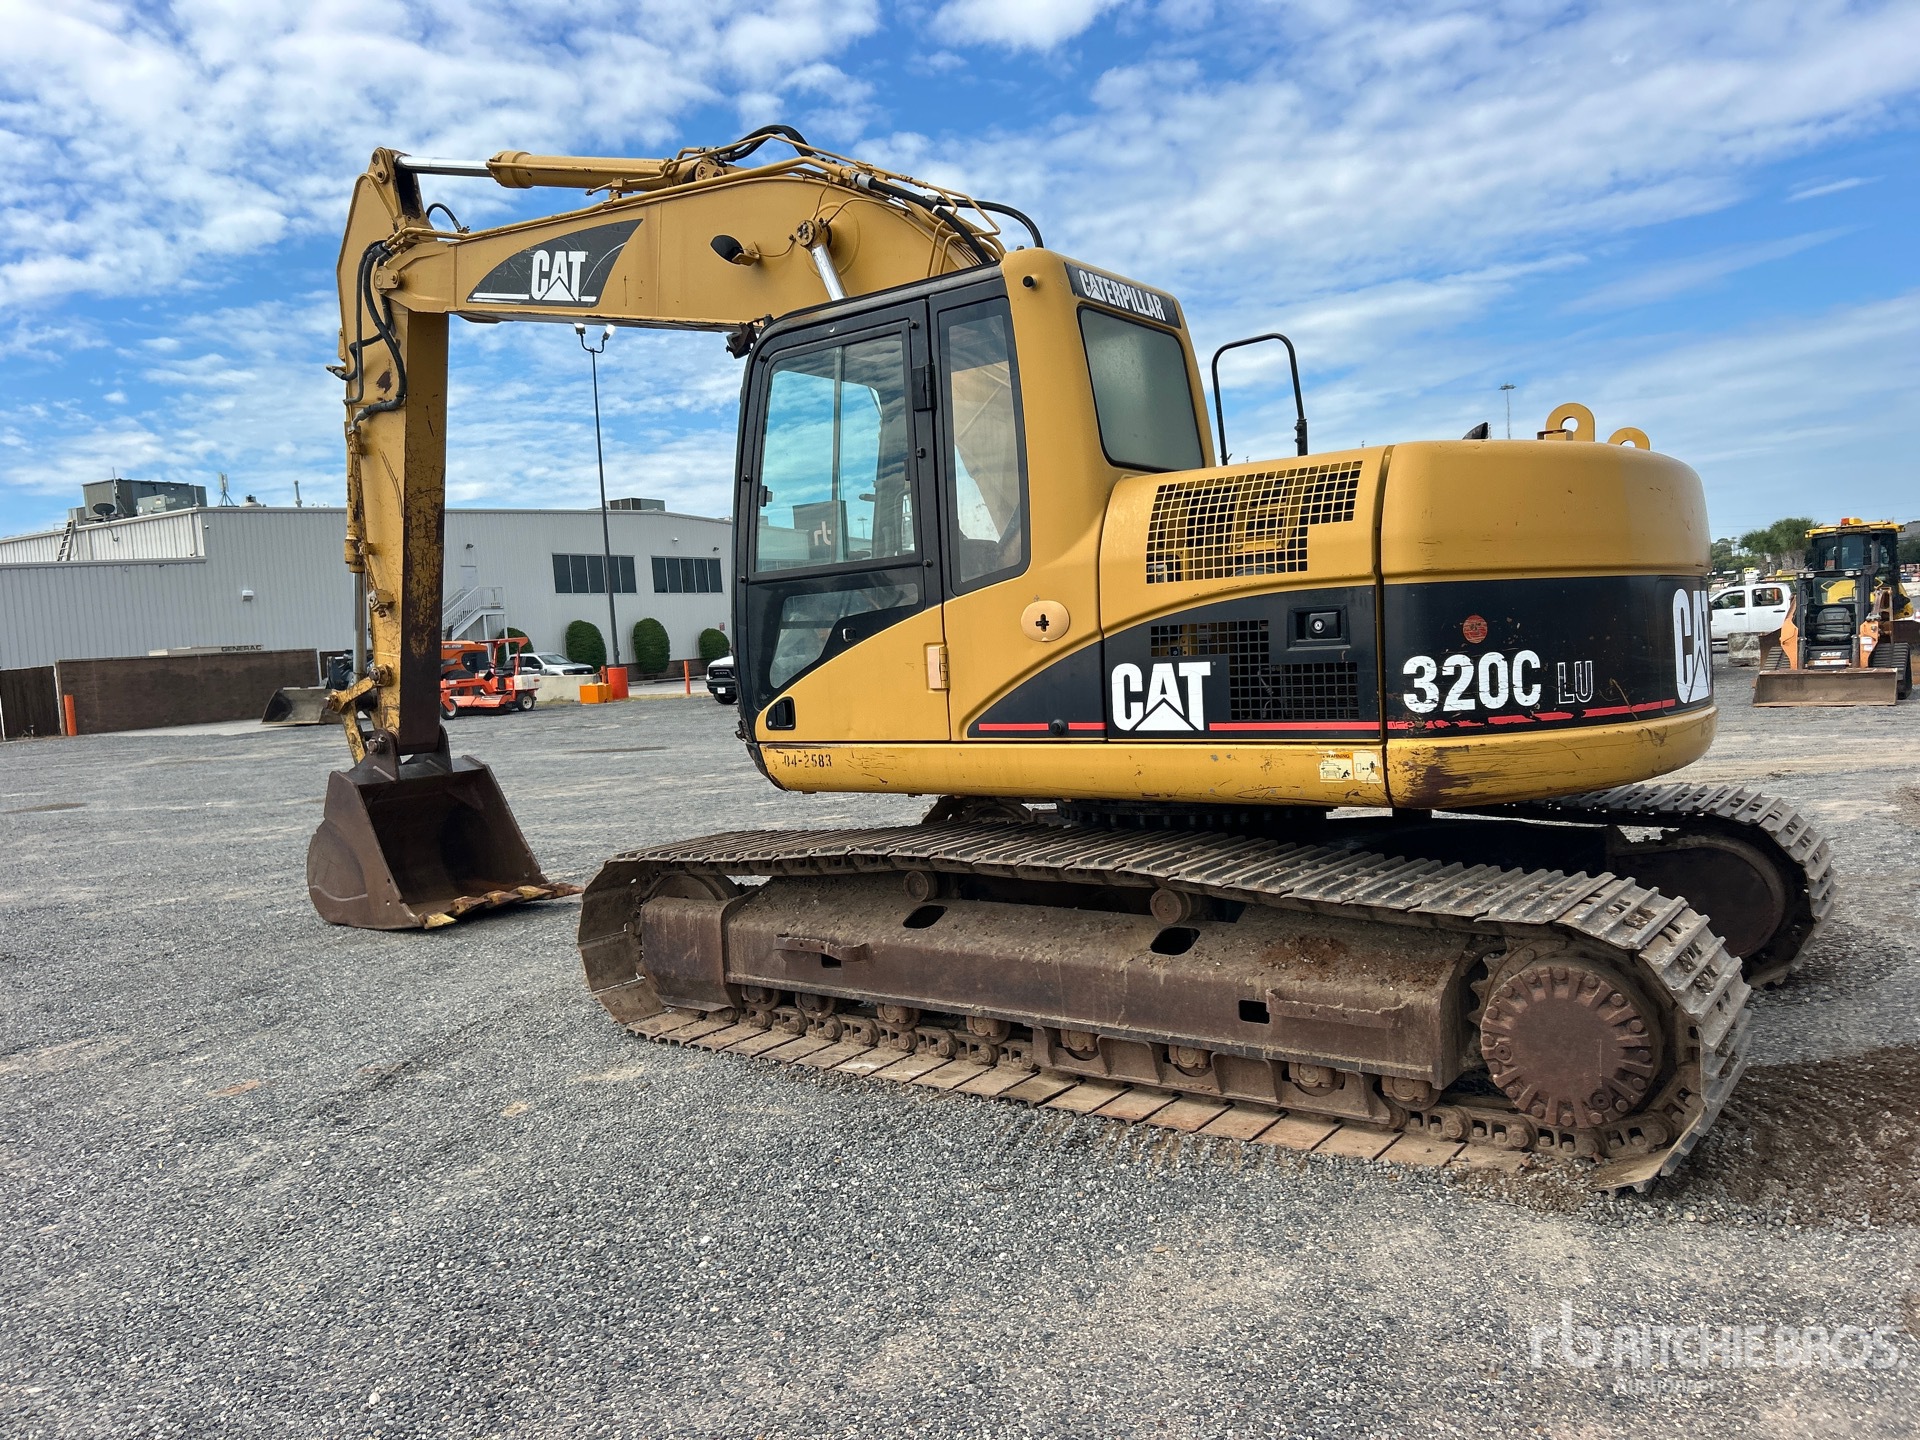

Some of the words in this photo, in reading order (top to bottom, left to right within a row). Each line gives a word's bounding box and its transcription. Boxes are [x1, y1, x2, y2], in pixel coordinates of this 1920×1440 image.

[531, 249, 587, 301] CAT
[1078, 269, 1167, 322] CATERPILLAR
[1111, 661, 1212, 731] CAT
[1402, 649, 1542, 714] 320C
[1557, 660, 1594, 704] LU
